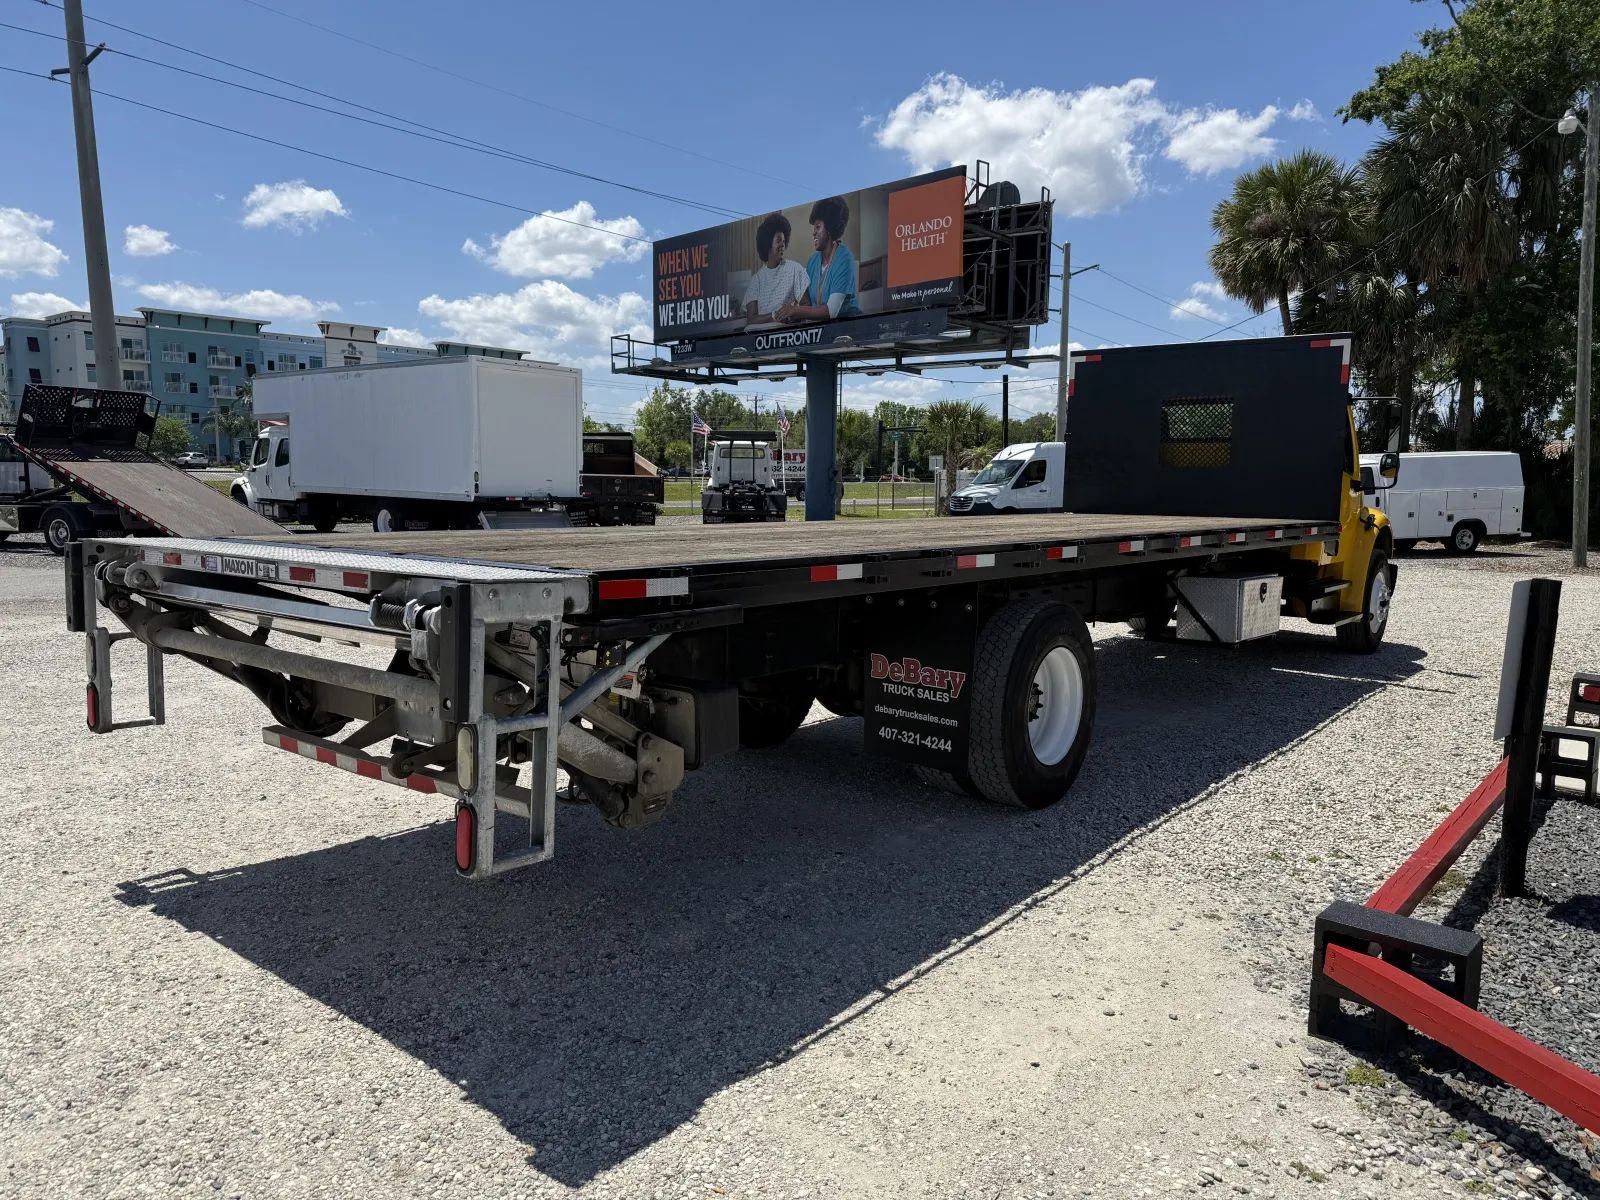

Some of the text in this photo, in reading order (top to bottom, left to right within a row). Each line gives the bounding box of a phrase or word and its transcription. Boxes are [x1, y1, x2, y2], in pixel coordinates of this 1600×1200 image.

[895, 216, 952, 238] ORLANDO
[901, 232, 945, 252] HEALTH
[659, 244, 709, 276] WHEN WE
[659, 272, 704, 302] SEE YOU,
[922, 281, 954, 301] personal
[659, 294, 732, 327] WE HEAR YOU.
[224, 559, 254, 575] MAXON
[870, 653, 966, 698] DeBary
[882, 682, 949, 702] TRUCK SALES
[875, 704, 958, 727] debarytrucksales.com
[879, 726, 952, 752] 407-321-4244
